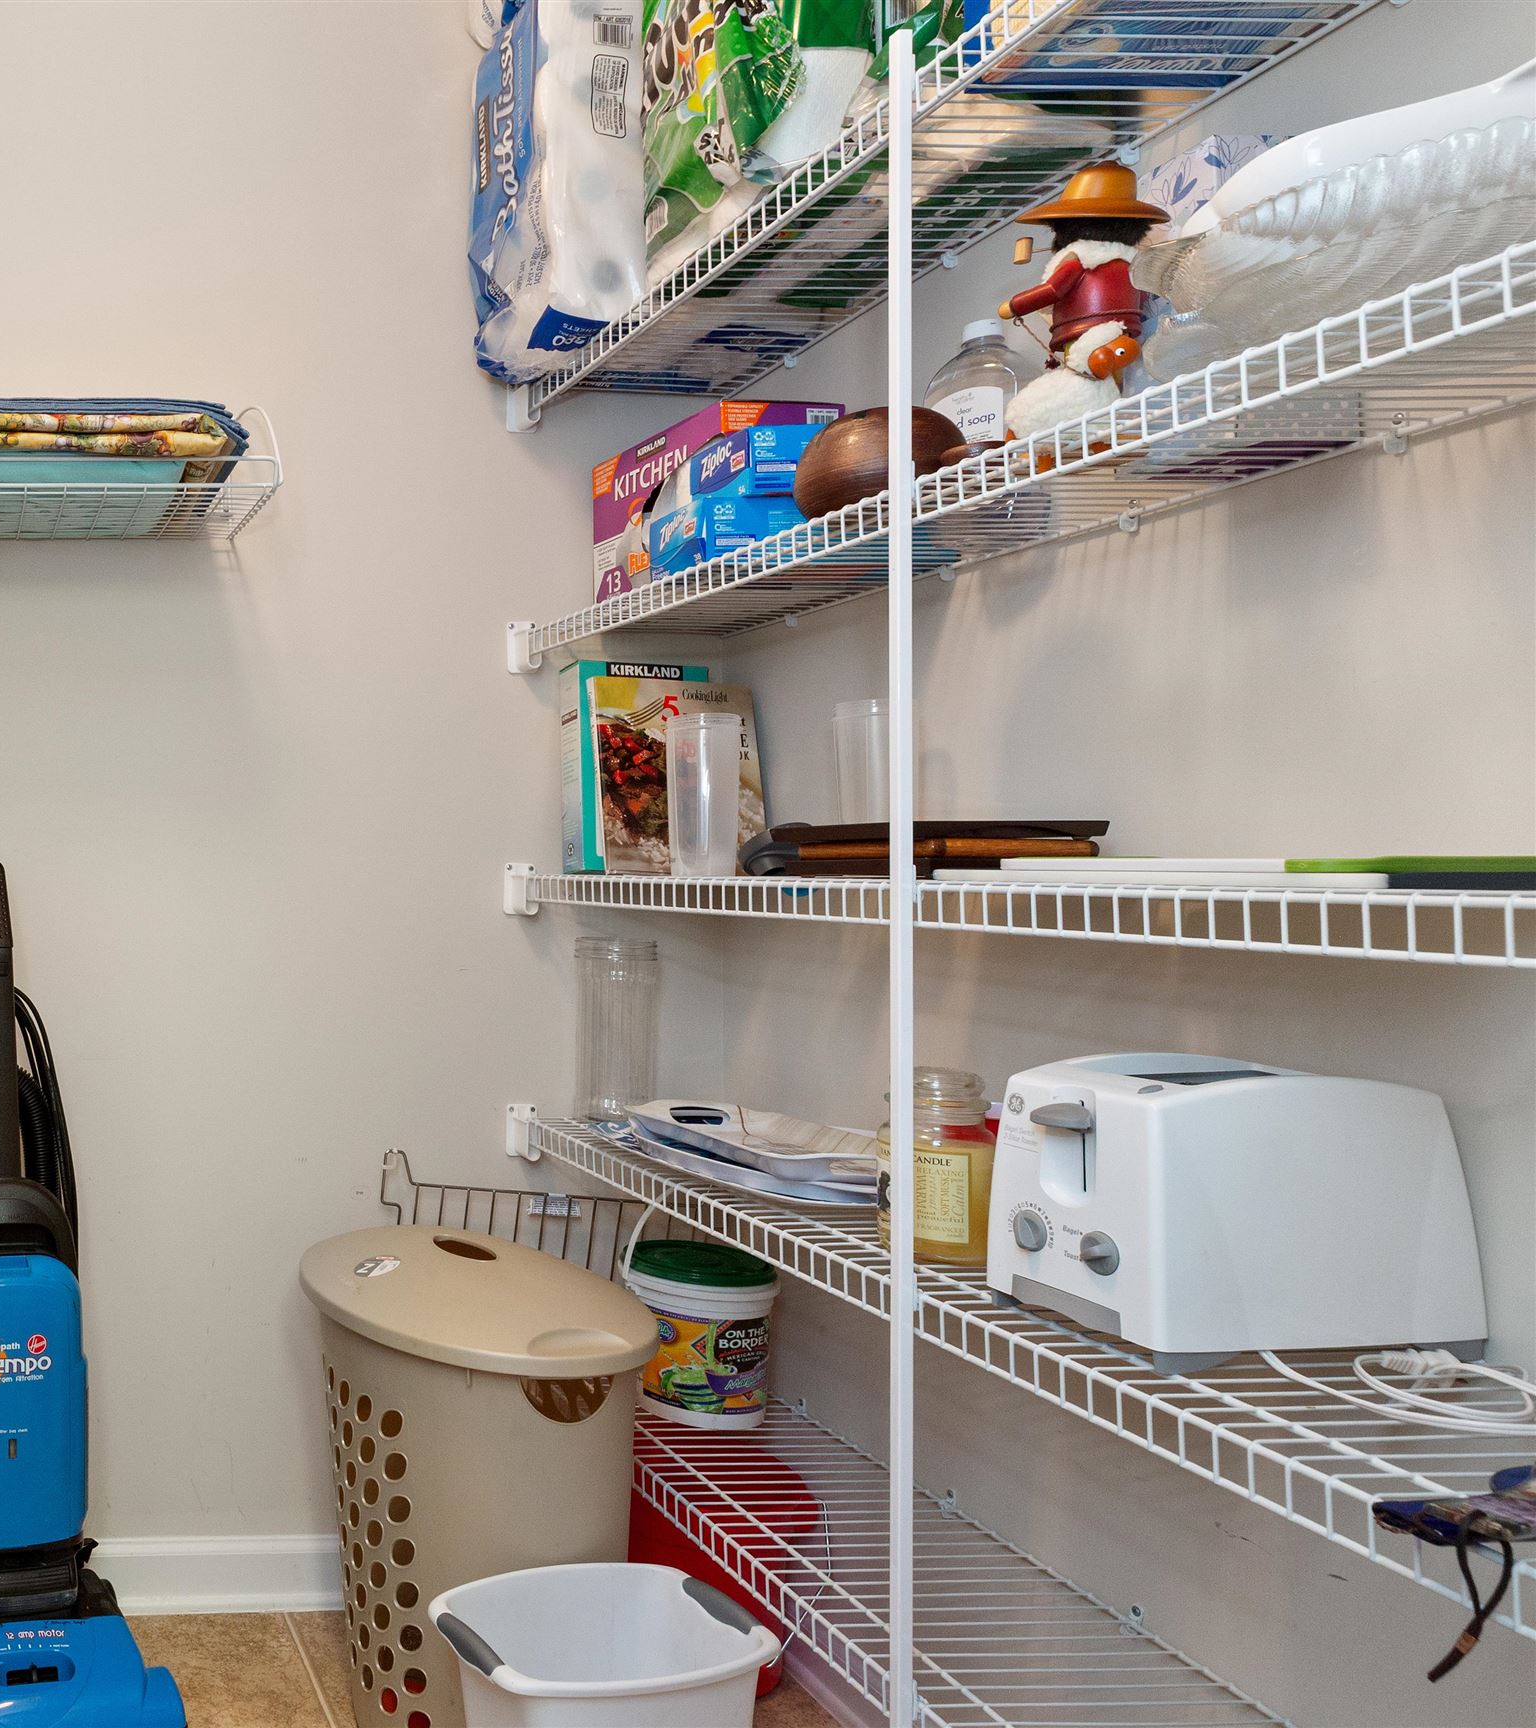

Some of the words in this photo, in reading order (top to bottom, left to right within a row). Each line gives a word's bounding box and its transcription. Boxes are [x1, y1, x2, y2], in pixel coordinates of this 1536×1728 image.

[493, 22, 515, 136] Tissu
[478, 104, 489, 190] KIRKLAND
[490, 120, 519, 242] Bath
[956, 407, 973, 416] clear
[967, 412, 996, 427] soap
[636, 436, 666, 457] KIRKLAND
[700, 441, 733, 482] Ziploc
[614, 444, 688, 502] KITCHEN
[659, 508, 688, 553] Ziploc
[628, 551, 651, 577] FLE
[606, 570, 622, 594] 13
[610, 663, 681, 678] KIRKLAND
[661, 695, 680, 722] 5
[682, 688, 711, 704] Cooking
[710, 690, 729, 703] Light
[916, 1167, 965, 1177] RELAXING
[916, 1175, 927, 1209] WARM
[951, 1185, 965, 1217] Calm
[940, 1199, 950, 1217] SOFT
[1062, 1224, 1080, 1237] Bagel
[1063, 1249, 1080, 1261] Toast
[718, 1335, 768, 1351] BORDER
[725, 1329, 745, 1339] ON
[747, 1327, 766, 1338] THE
[726, 1351, 755, 1361] MEXICAN
[18, 1631, 35, 1639] amp
[38, 1629, 65, 1638] motor
